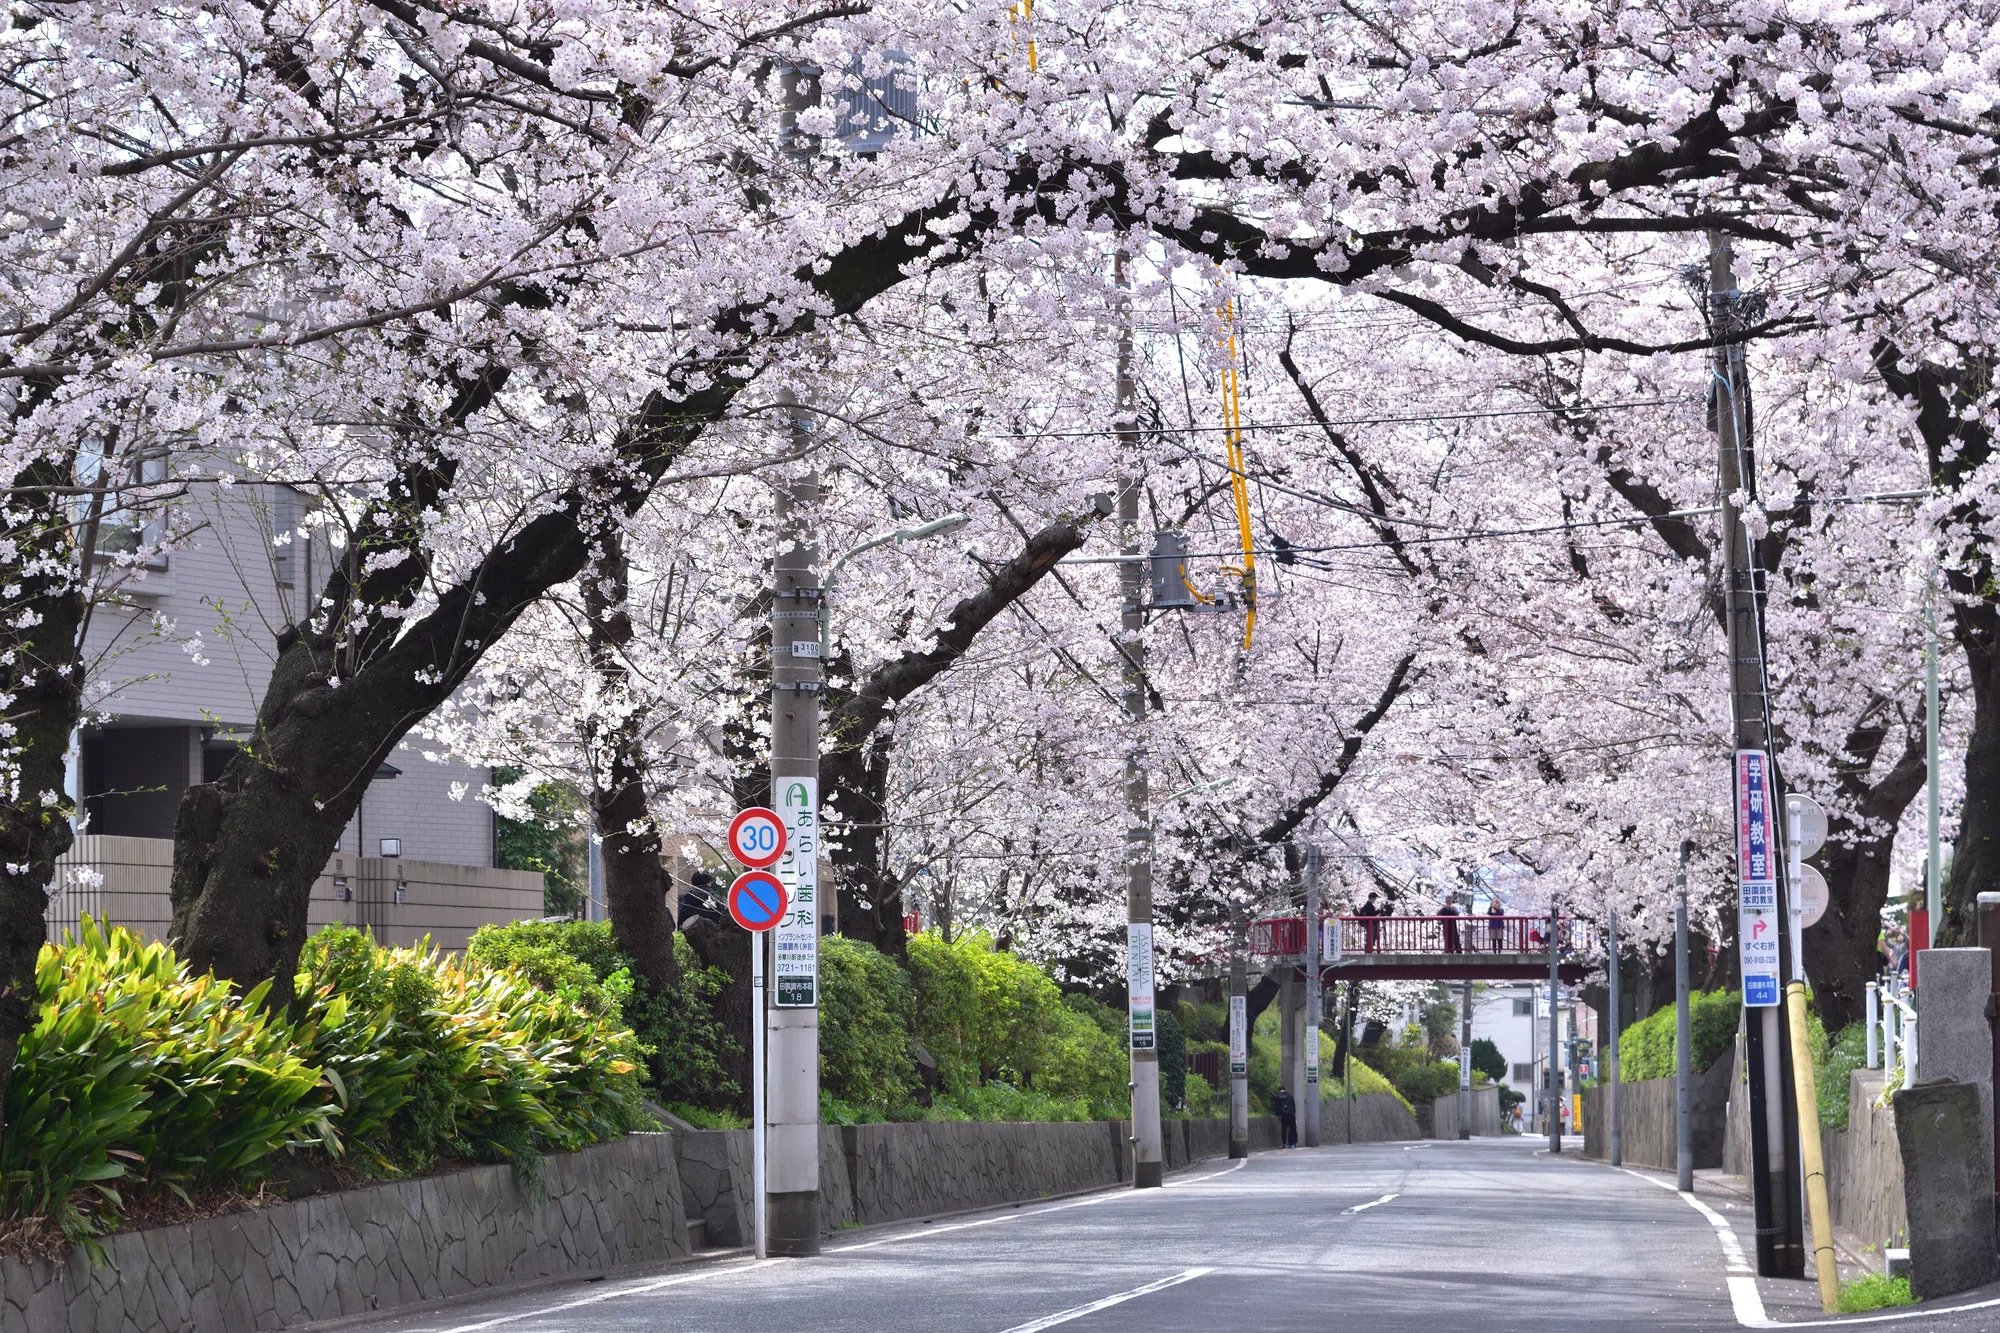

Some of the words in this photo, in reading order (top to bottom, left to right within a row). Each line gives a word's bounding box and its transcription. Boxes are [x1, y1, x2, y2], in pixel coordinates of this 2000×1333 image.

[800, 643, 819, 652] 3100
[1749, 759, 1766, 877] 学研教室
[742, 825, 774, 851] 30
[797, 810, 814, 928] あらい歯科
[1743, 886, 1773, 895] 田園調布
[1743, 896, 1773, 904] 本町教室
[778, 933, 814, 941] インプラントセンター
[1744, 942, 1775, 950] すぐ右折
[1131, 936, 1139, 983] DENTAL
[1141, 934, 1150, 985] ASAKURA
[791, 993, 802, 1001] 18
